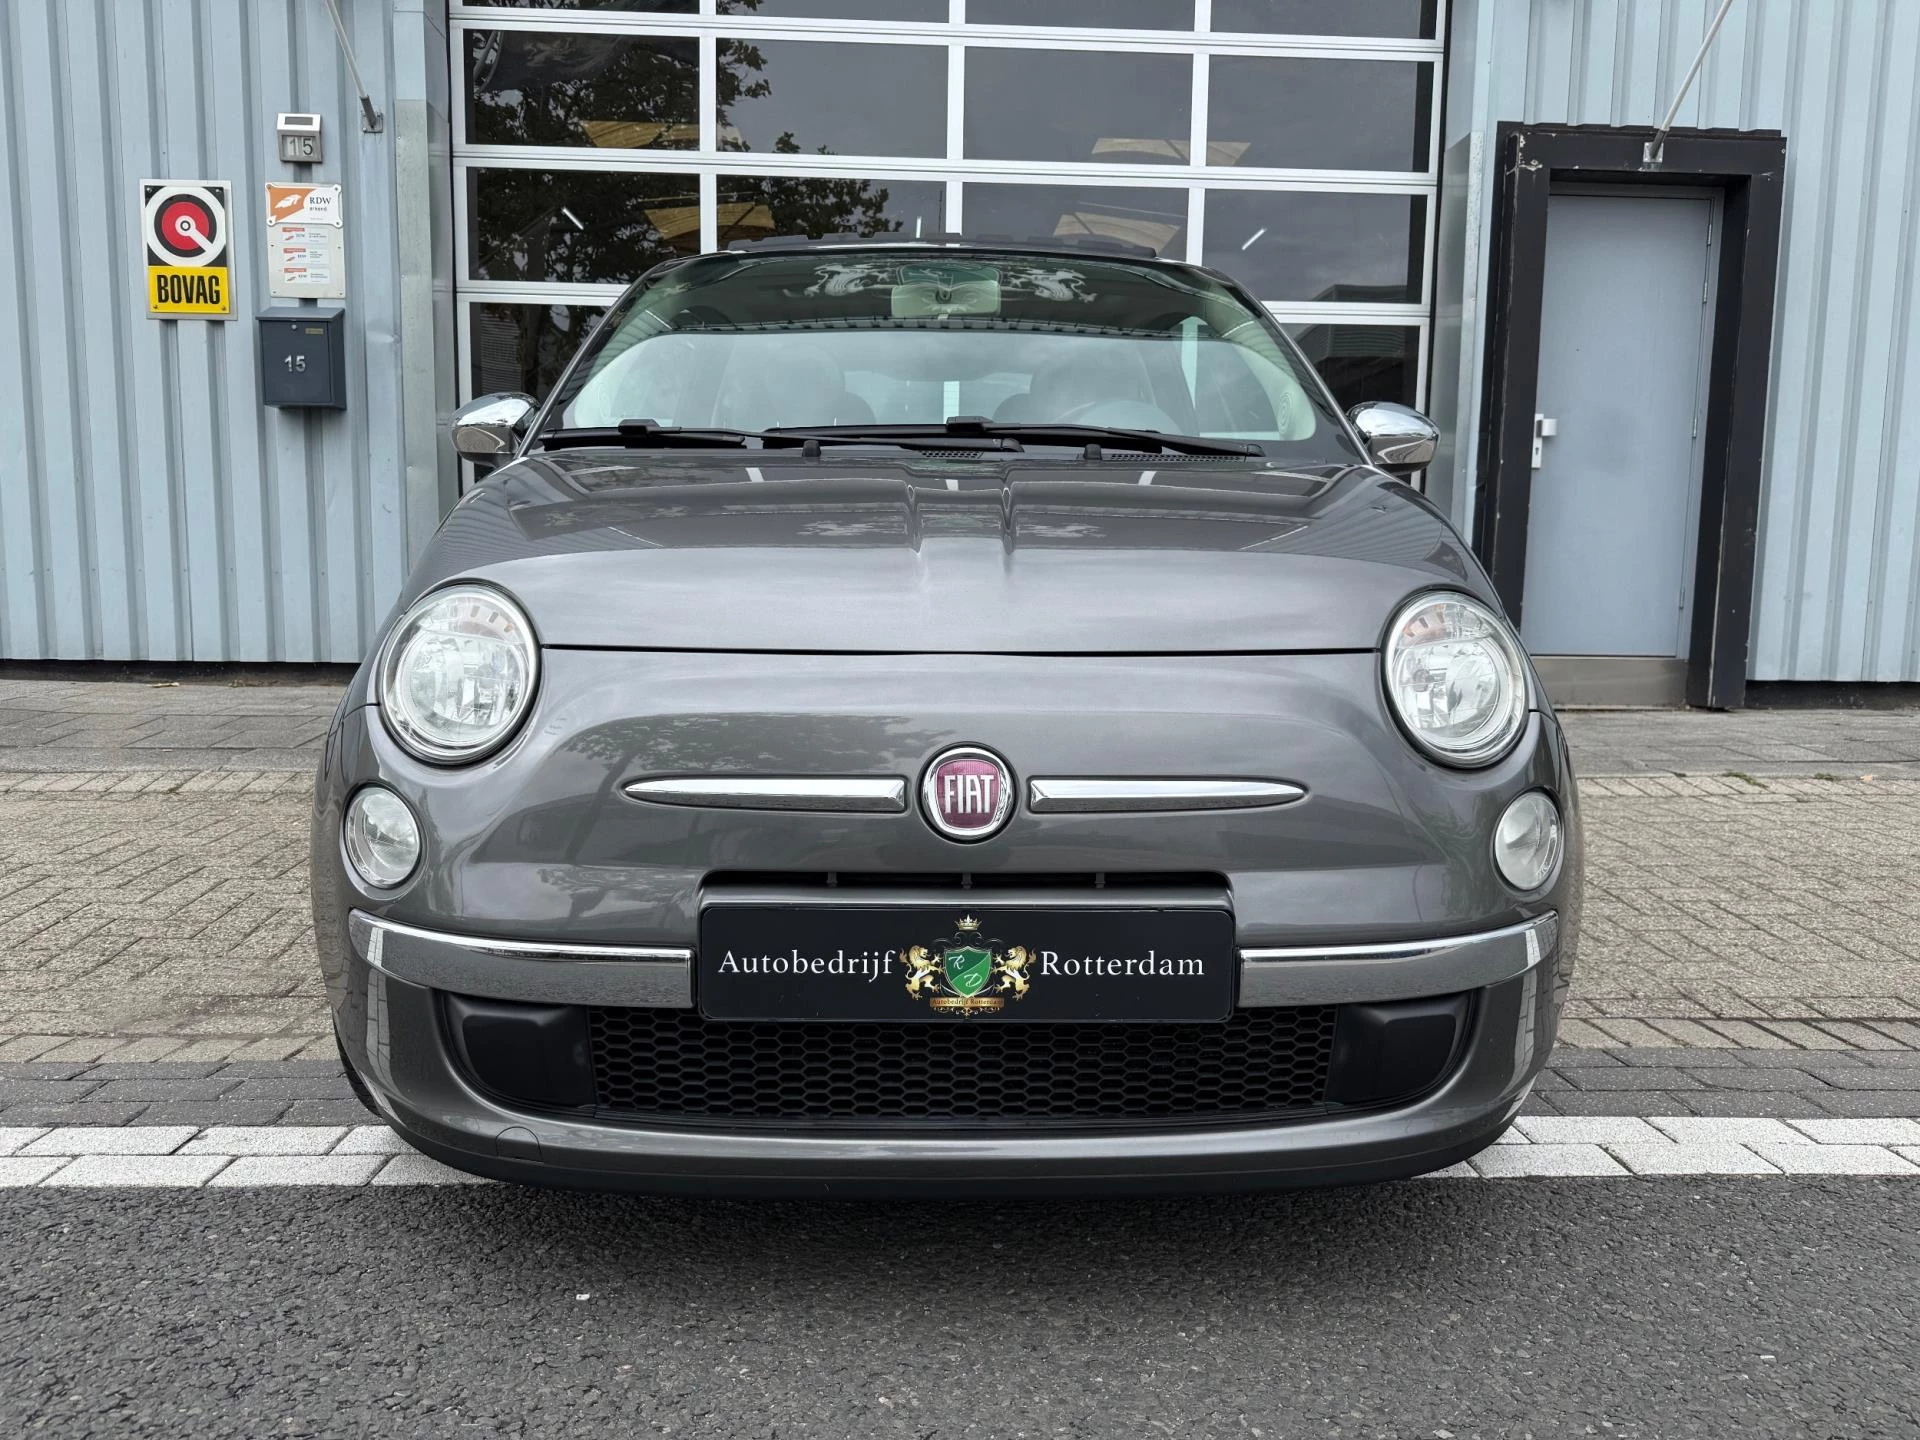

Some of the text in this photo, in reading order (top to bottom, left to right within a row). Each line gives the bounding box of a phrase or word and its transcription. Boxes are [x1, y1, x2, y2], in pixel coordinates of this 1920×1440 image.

[289, 138, 313, 156] 15
[309, 196, 331, 205] RDW
[156, 274, 221, 305] BOVAG
[284, 354, 306, 372] 15
[943, 774, 995, 814] FIAT
[718, 949, 1205, 983] Autobedrijf Rotterdam
